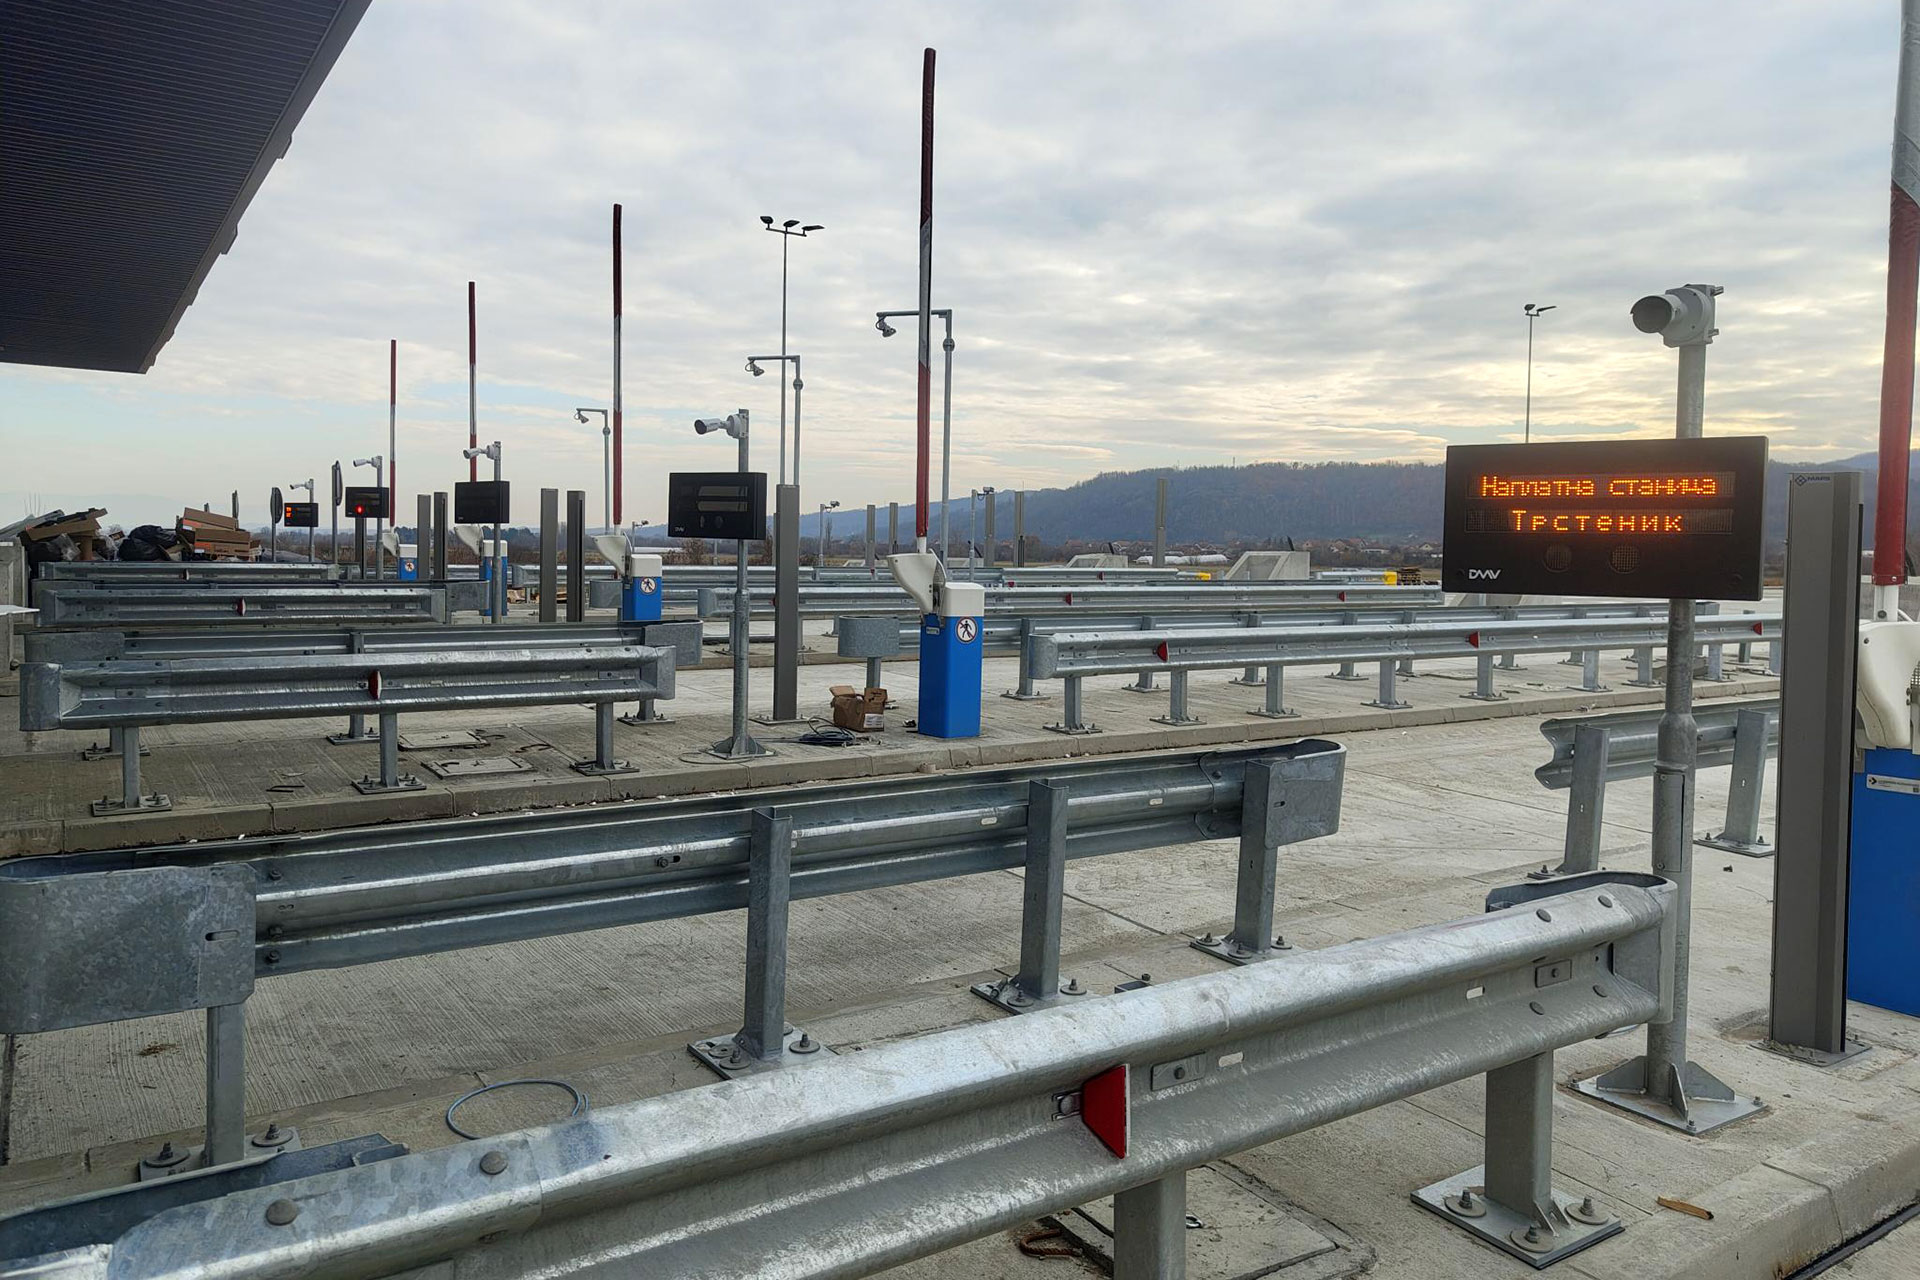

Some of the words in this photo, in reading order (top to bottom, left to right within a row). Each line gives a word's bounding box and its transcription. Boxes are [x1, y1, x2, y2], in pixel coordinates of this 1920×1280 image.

[1480, 476, 1595, 497] Наплатна
[1608, 477, 1717, 496] станица
[1511, 509, 1683, 532] Трстеник
